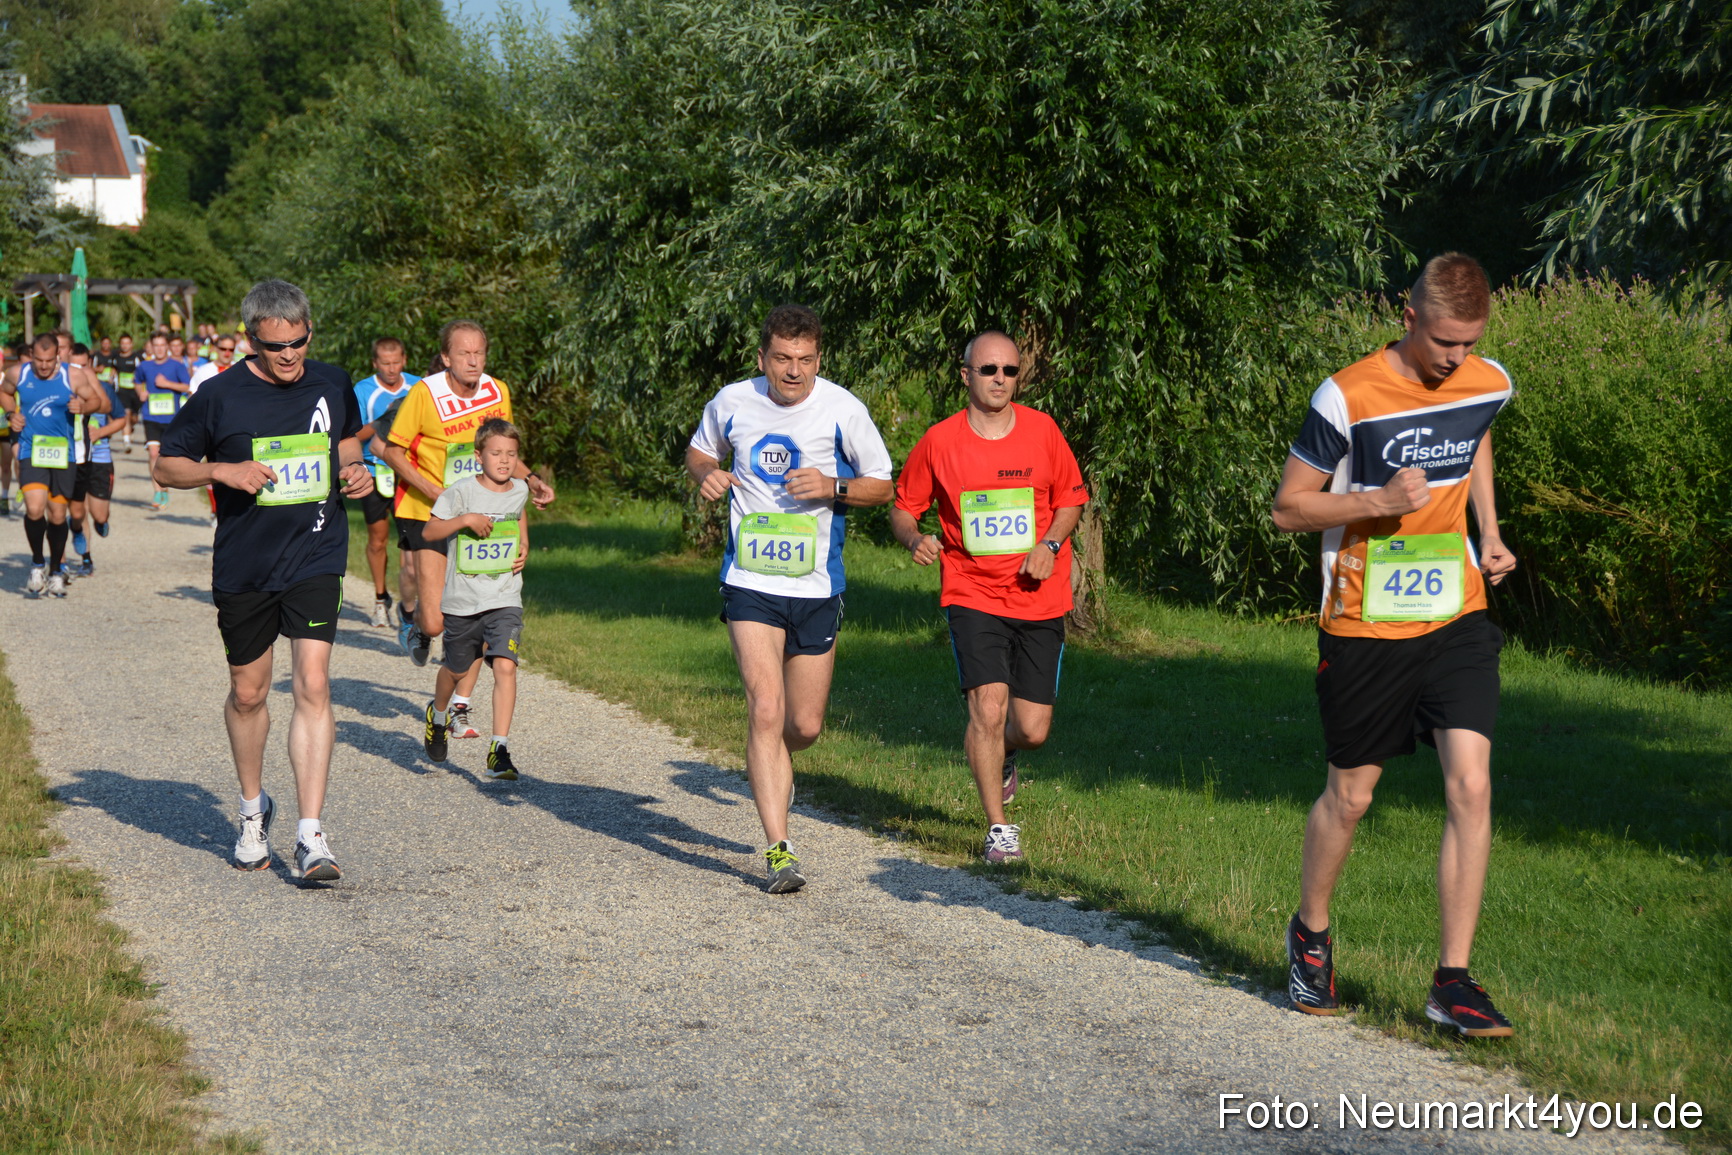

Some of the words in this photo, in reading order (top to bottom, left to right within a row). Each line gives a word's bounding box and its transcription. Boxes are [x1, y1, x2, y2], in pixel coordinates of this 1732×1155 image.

[443, 419, 475, 436] MAX
[39, 448, 60, 459] 850
[762, 452, 789, 464] TÜV
[1401, 439, 1475, 462] Fischer
[454, 458, 483, 474] 946
[1409, 455, 1471, 469] AUTOMOBILE
[997, 469, 1023, 477] swn
[970, 515, 1028, 537] 1526
[464, 542, 513, 560] 1537
[747, 538, 805, 562] 1481
[1383, 568, 1443, 596] 426
